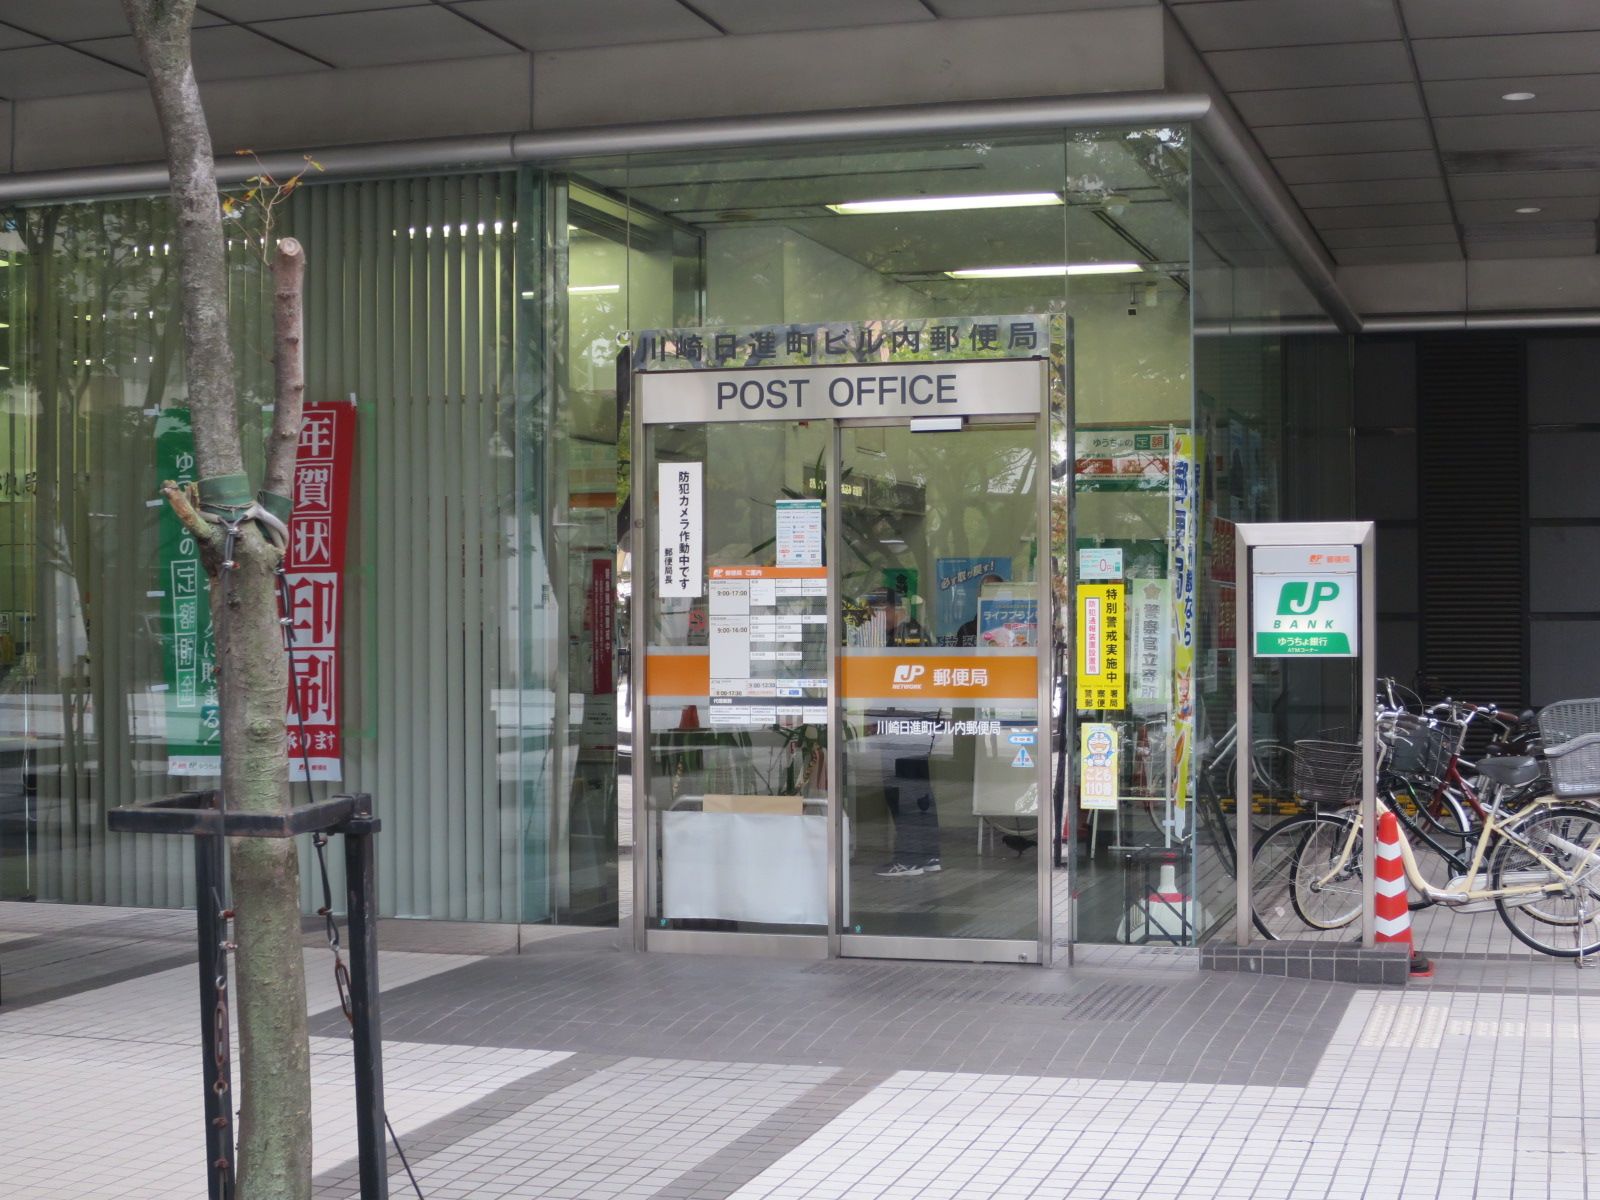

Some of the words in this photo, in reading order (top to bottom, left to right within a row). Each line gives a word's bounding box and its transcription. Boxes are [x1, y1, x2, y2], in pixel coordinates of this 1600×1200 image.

[641, 322, 1038, 362] 川崎日進町ビル内郵便局
[717, 379, 810, 410] POST
[829, 374, 958, 407] OFFICE
[678, 471, 690, 590] 防犯カメラ作動中です
[664, 548, 673, 584] 郵便局長
[1276, 582, 1340, 615] JP
[1106, 588, 1118, 683] 特別警戒実施中
[1273, 620, 1334, 629] BANK
[1278, 637, 1328, 647] ゆうちょ銀行
[894, 665, 925, 683] JP
[933, 668, 988, 687] 郵便局
[876, 720, 1000, 736] 川崎日進町ビル内郵便局
